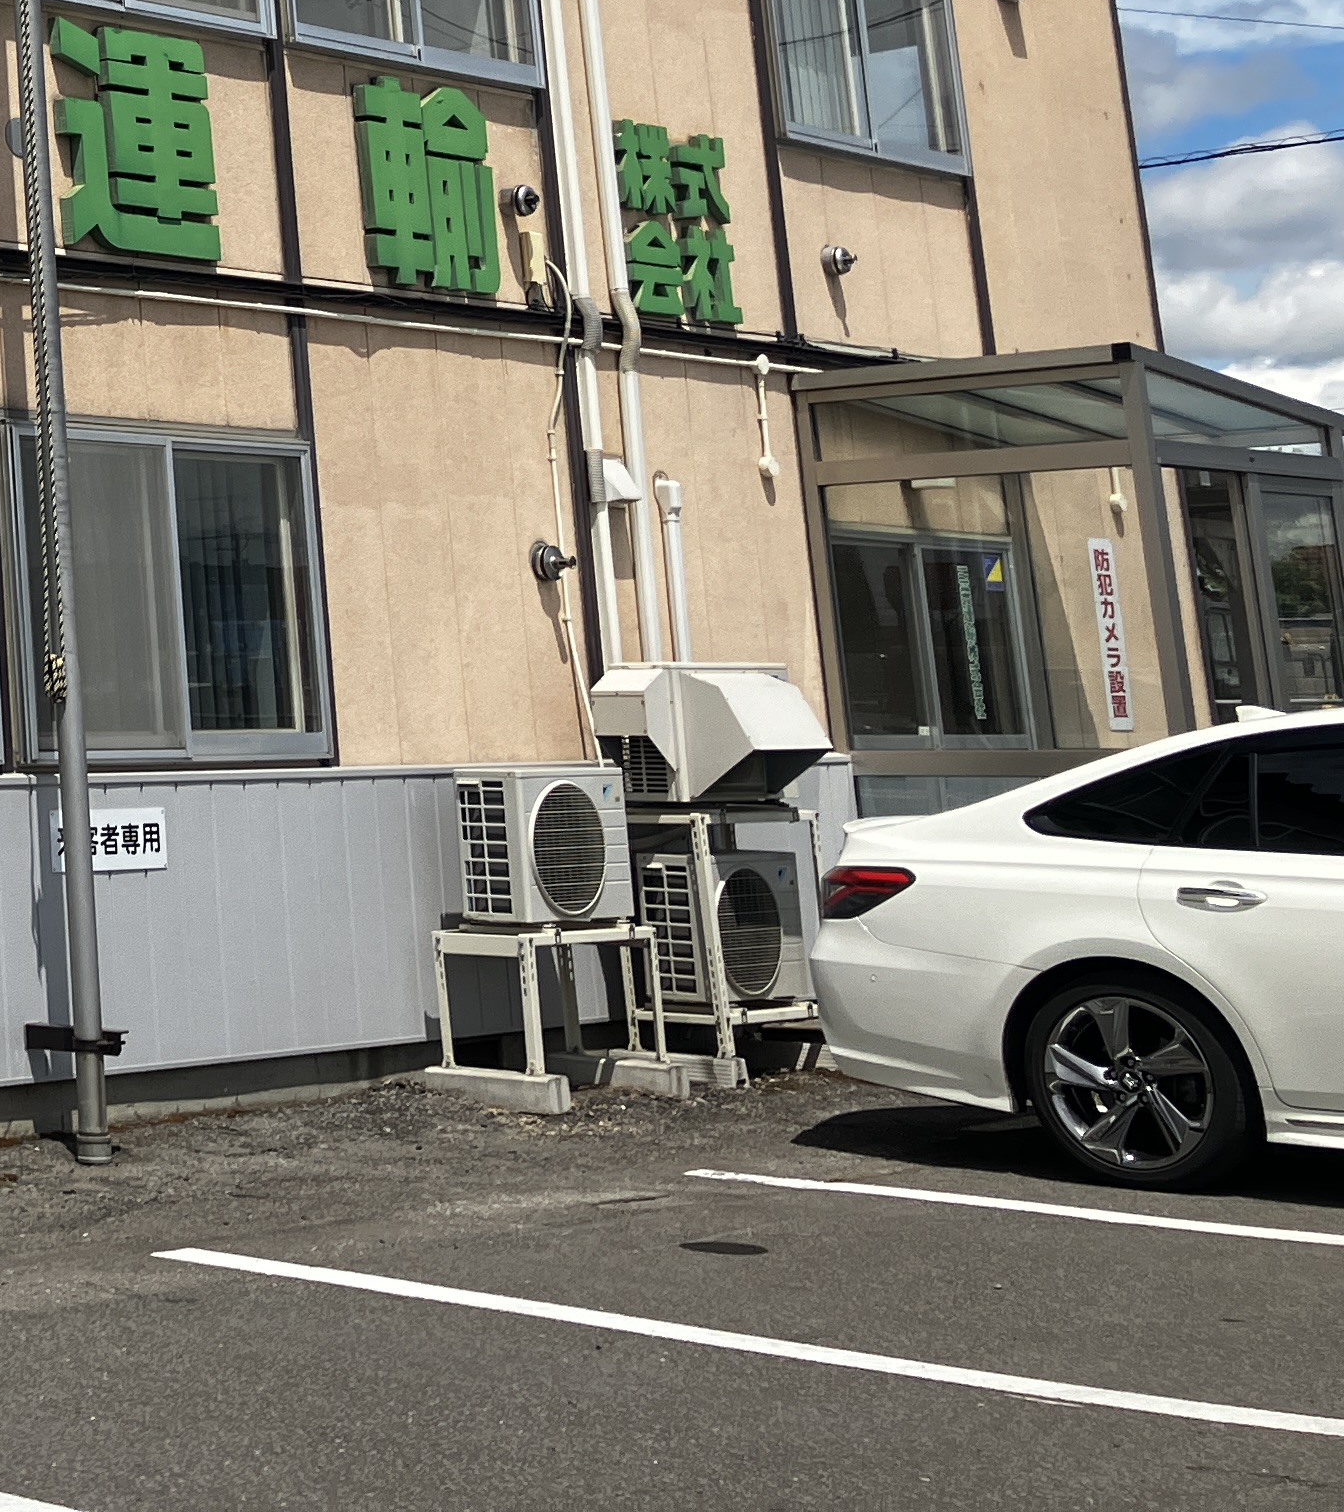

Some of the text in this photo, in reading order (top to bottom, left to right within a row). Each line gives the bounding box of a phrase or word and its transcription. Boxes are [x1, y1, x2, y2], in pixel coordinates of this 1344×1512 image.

[614, 119, 731, 224] 株式
[624, 220, 743, 325] 会社
[1093, 548, 1129, 719] 防犯カメラ設置
